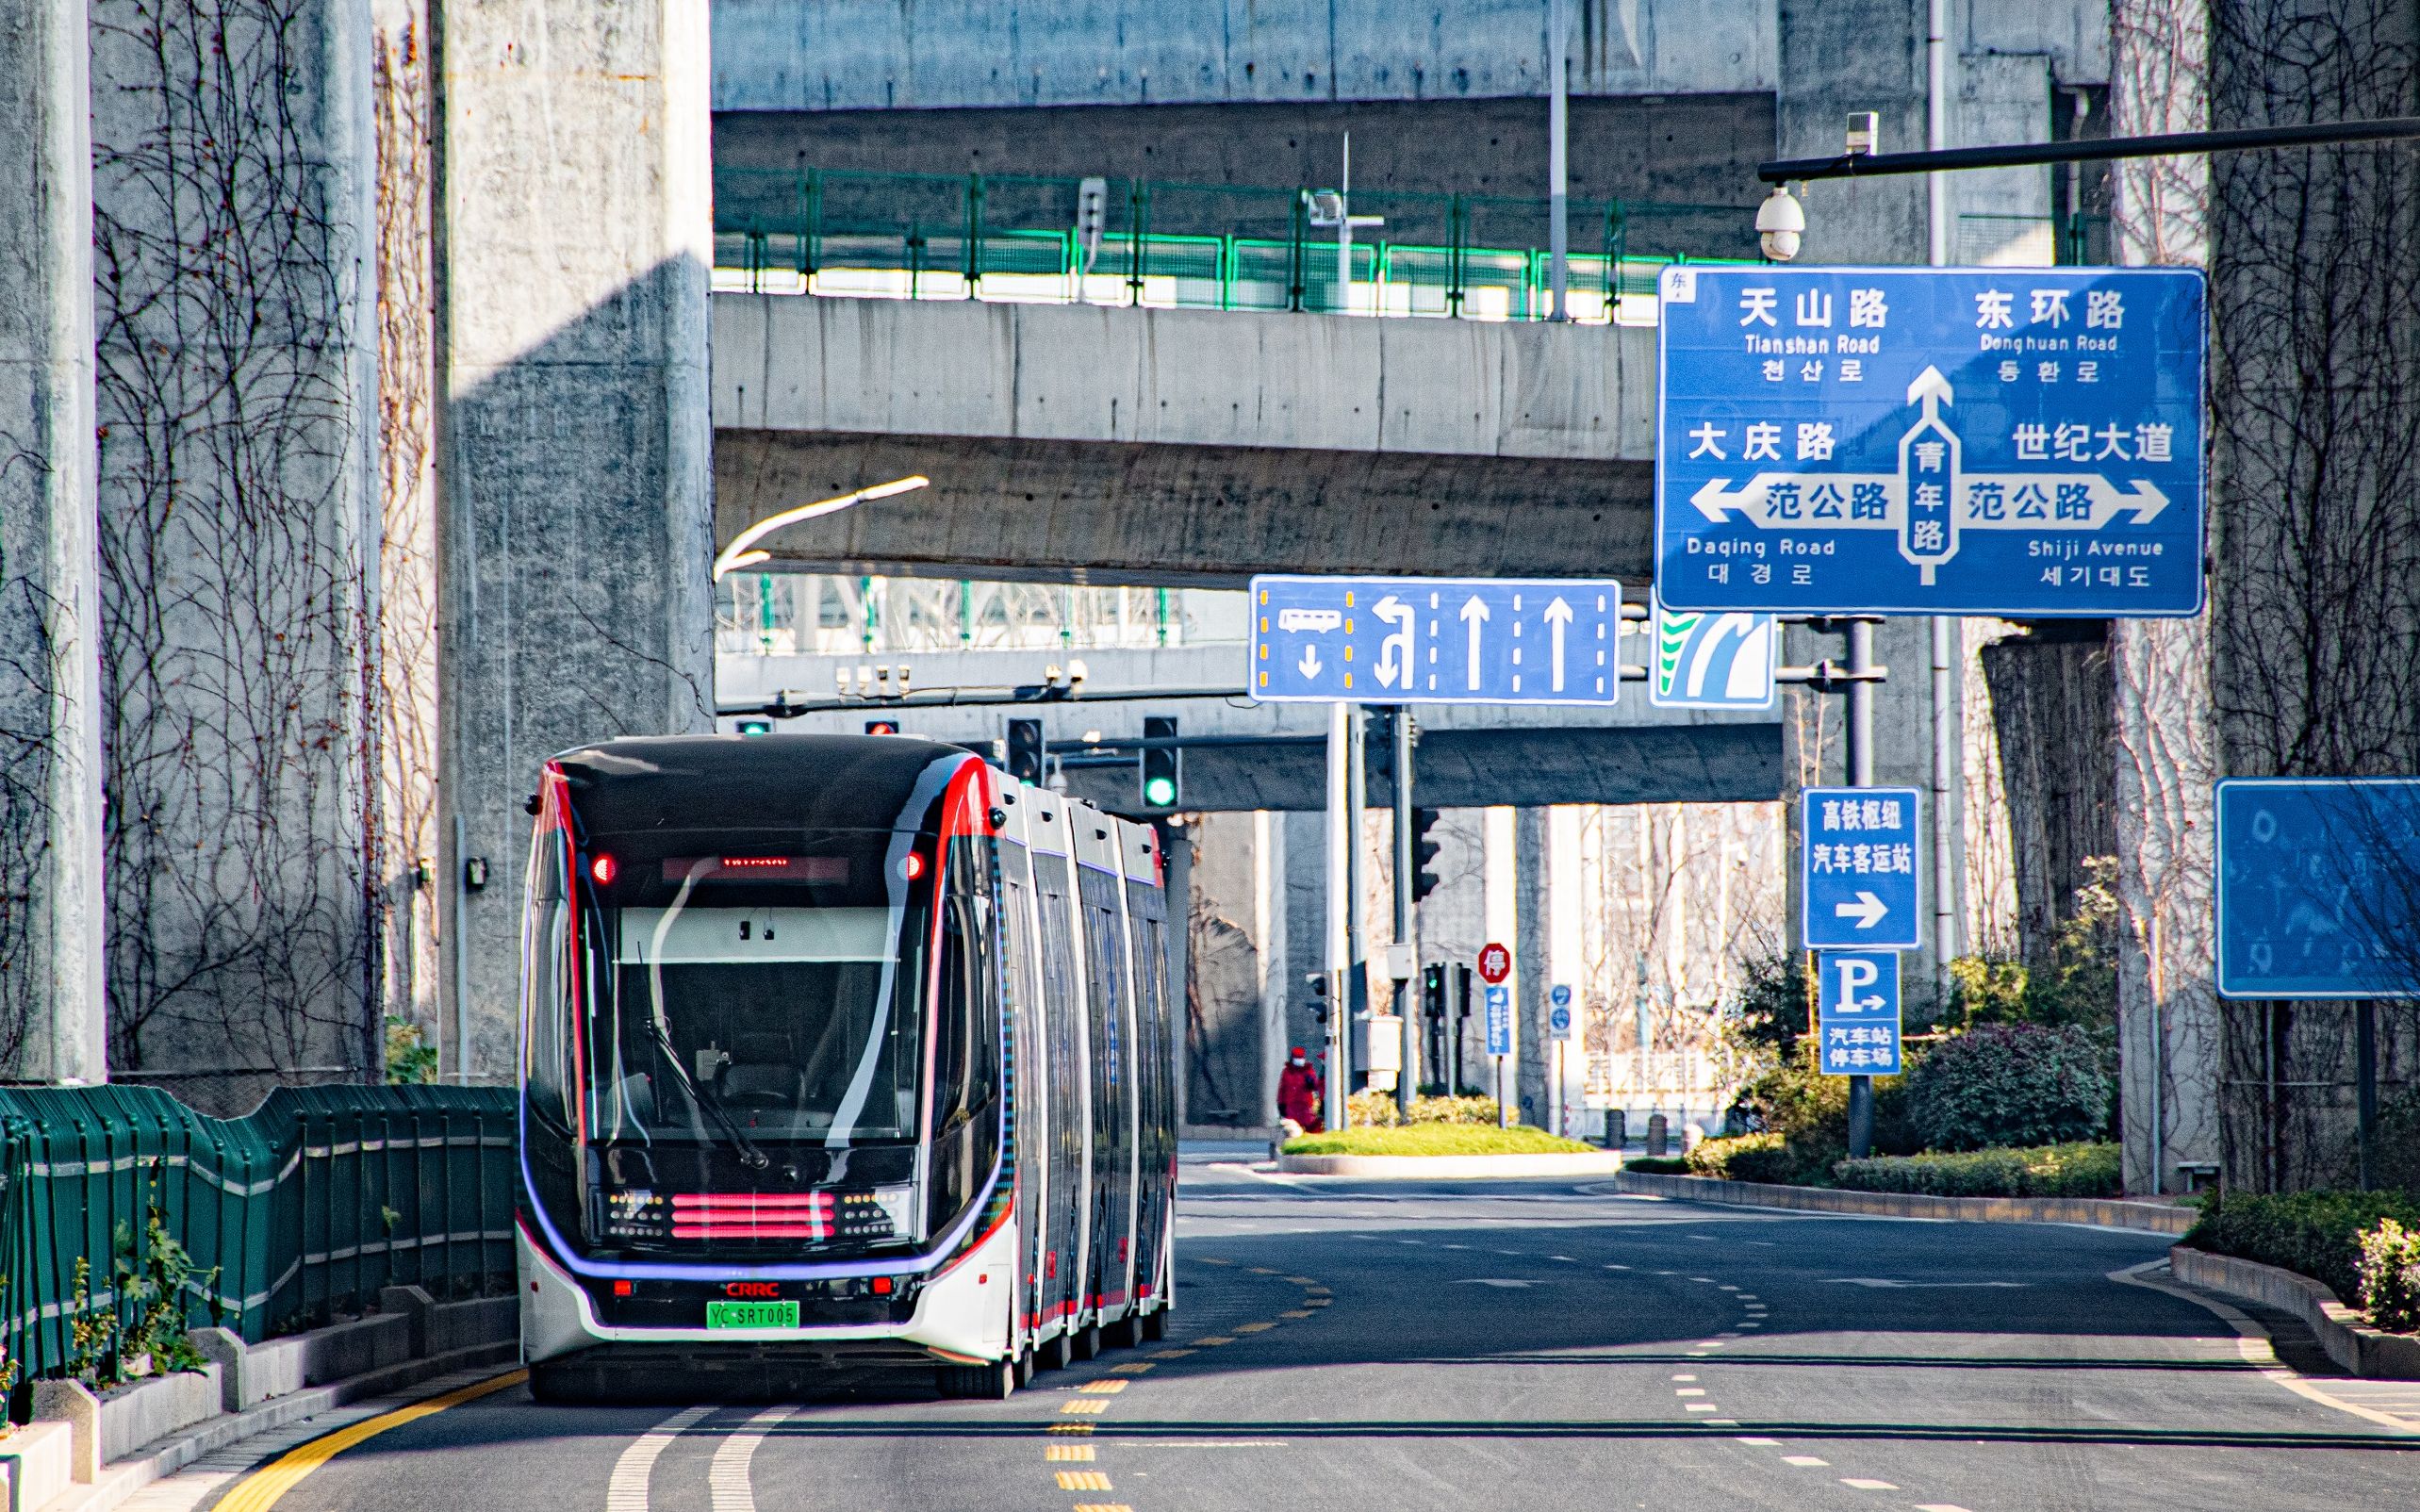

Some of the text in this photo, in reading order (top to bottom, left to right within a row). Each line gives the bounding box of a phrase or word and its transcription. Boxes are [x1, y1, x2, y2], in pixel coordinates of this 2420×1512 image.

[1739, 288, 1889, 328] 天山路
[1975, 288, 2125, 329] 东环路
[1745, 334, 1881, 354] Tianshan Road
[1981, 334, 2117, 355] Donghuan Road
[1688, 421, 1836, 462] 大庆路
[2012, 422, 2173, 462] 世纪大道
[1766, 483, 1890, 520] 范公路
[1914, 441, 1946, 551] 青年路
[1967, 483, 2095, 520] 范公路
[1687, 537, 1836, 559] Daqing Road
[2028, 539, 2164, 561] Shiji Avenue
[1822, 799, 1901, 831] 高铁枢纽
[1813, 844, 1913, 875] 汽车客运站
[1835, 959, 1879, 1013] P
[1829, 1026, 1893, 1046] 汽车站
[1829, 1047, 1894, 1068] 停车场
[726, 1282, 780, 1297] CRRC
